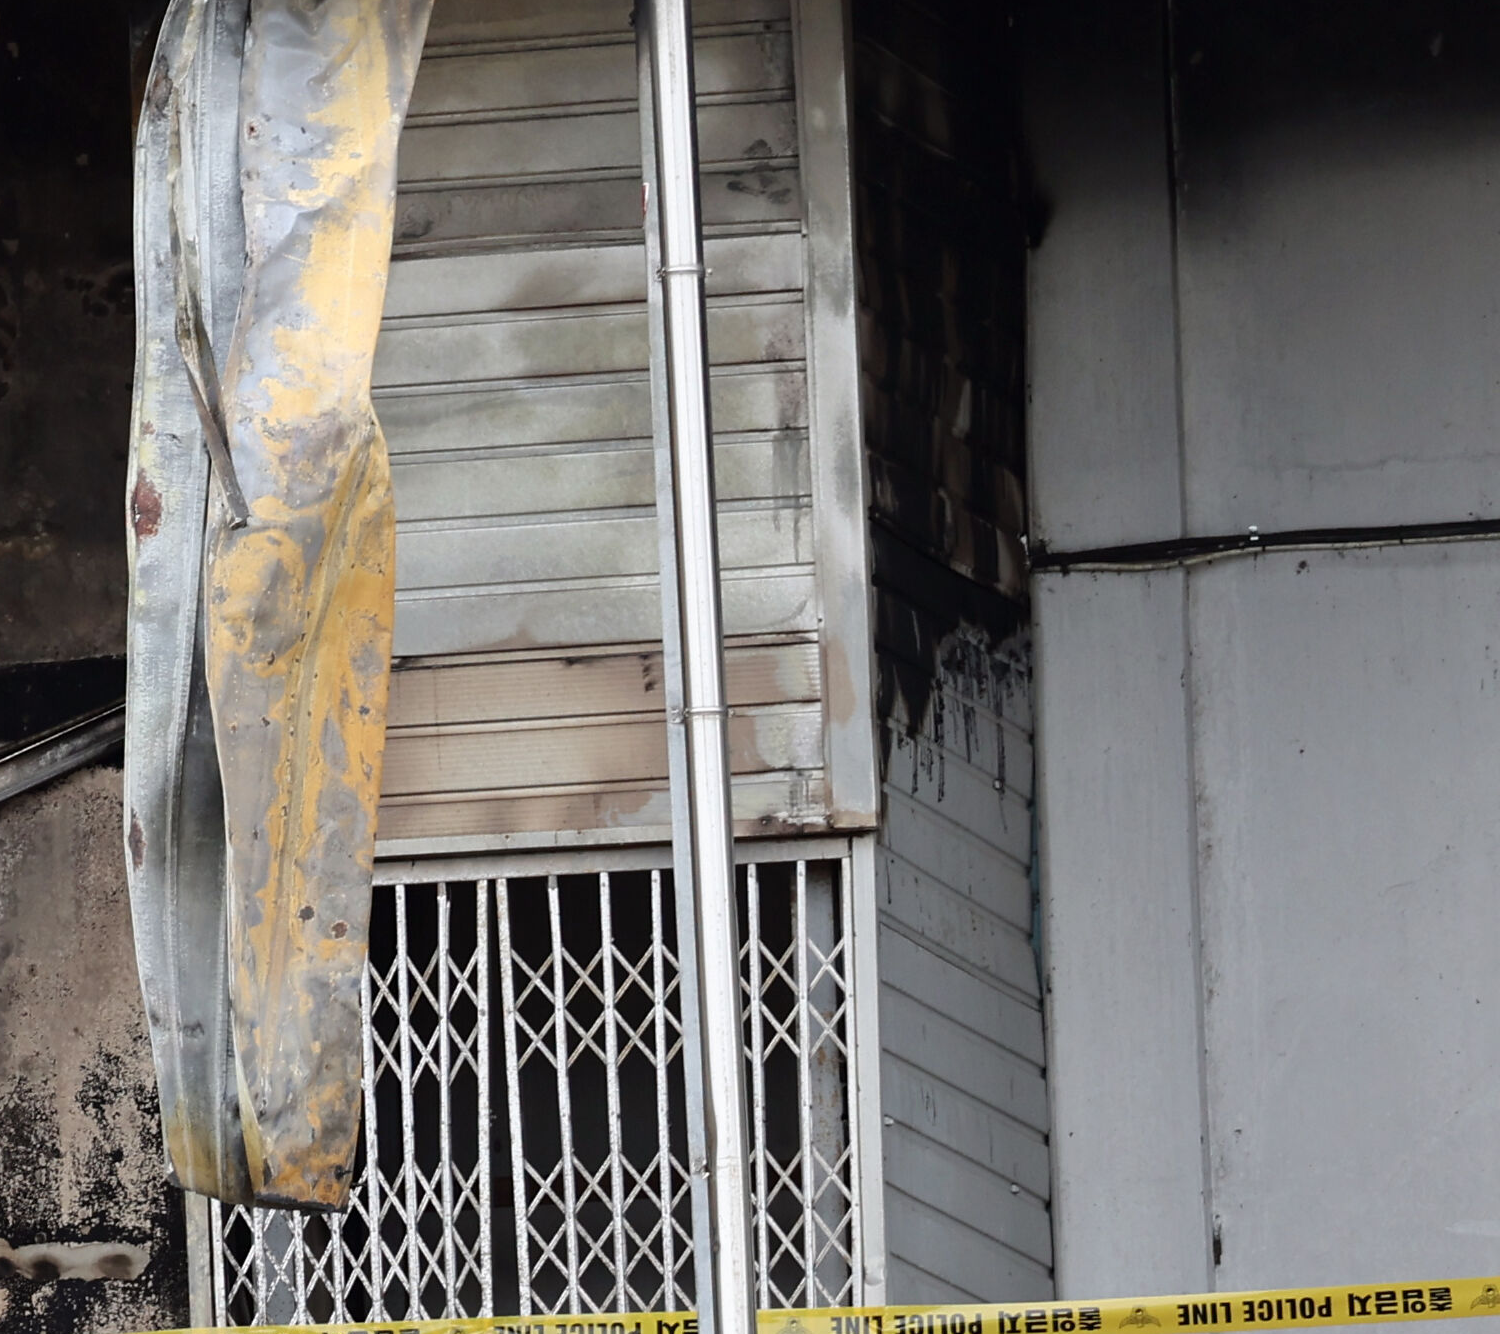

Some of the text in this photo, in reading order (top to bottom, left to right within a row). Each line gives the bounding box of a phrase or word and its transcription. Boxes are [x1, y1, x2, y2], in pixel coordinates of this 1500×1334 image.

[999, 1307, 1101, 1334] 출입금지
[1177, 1286, 1452, 1326] 출입금지 POLICE LINE
